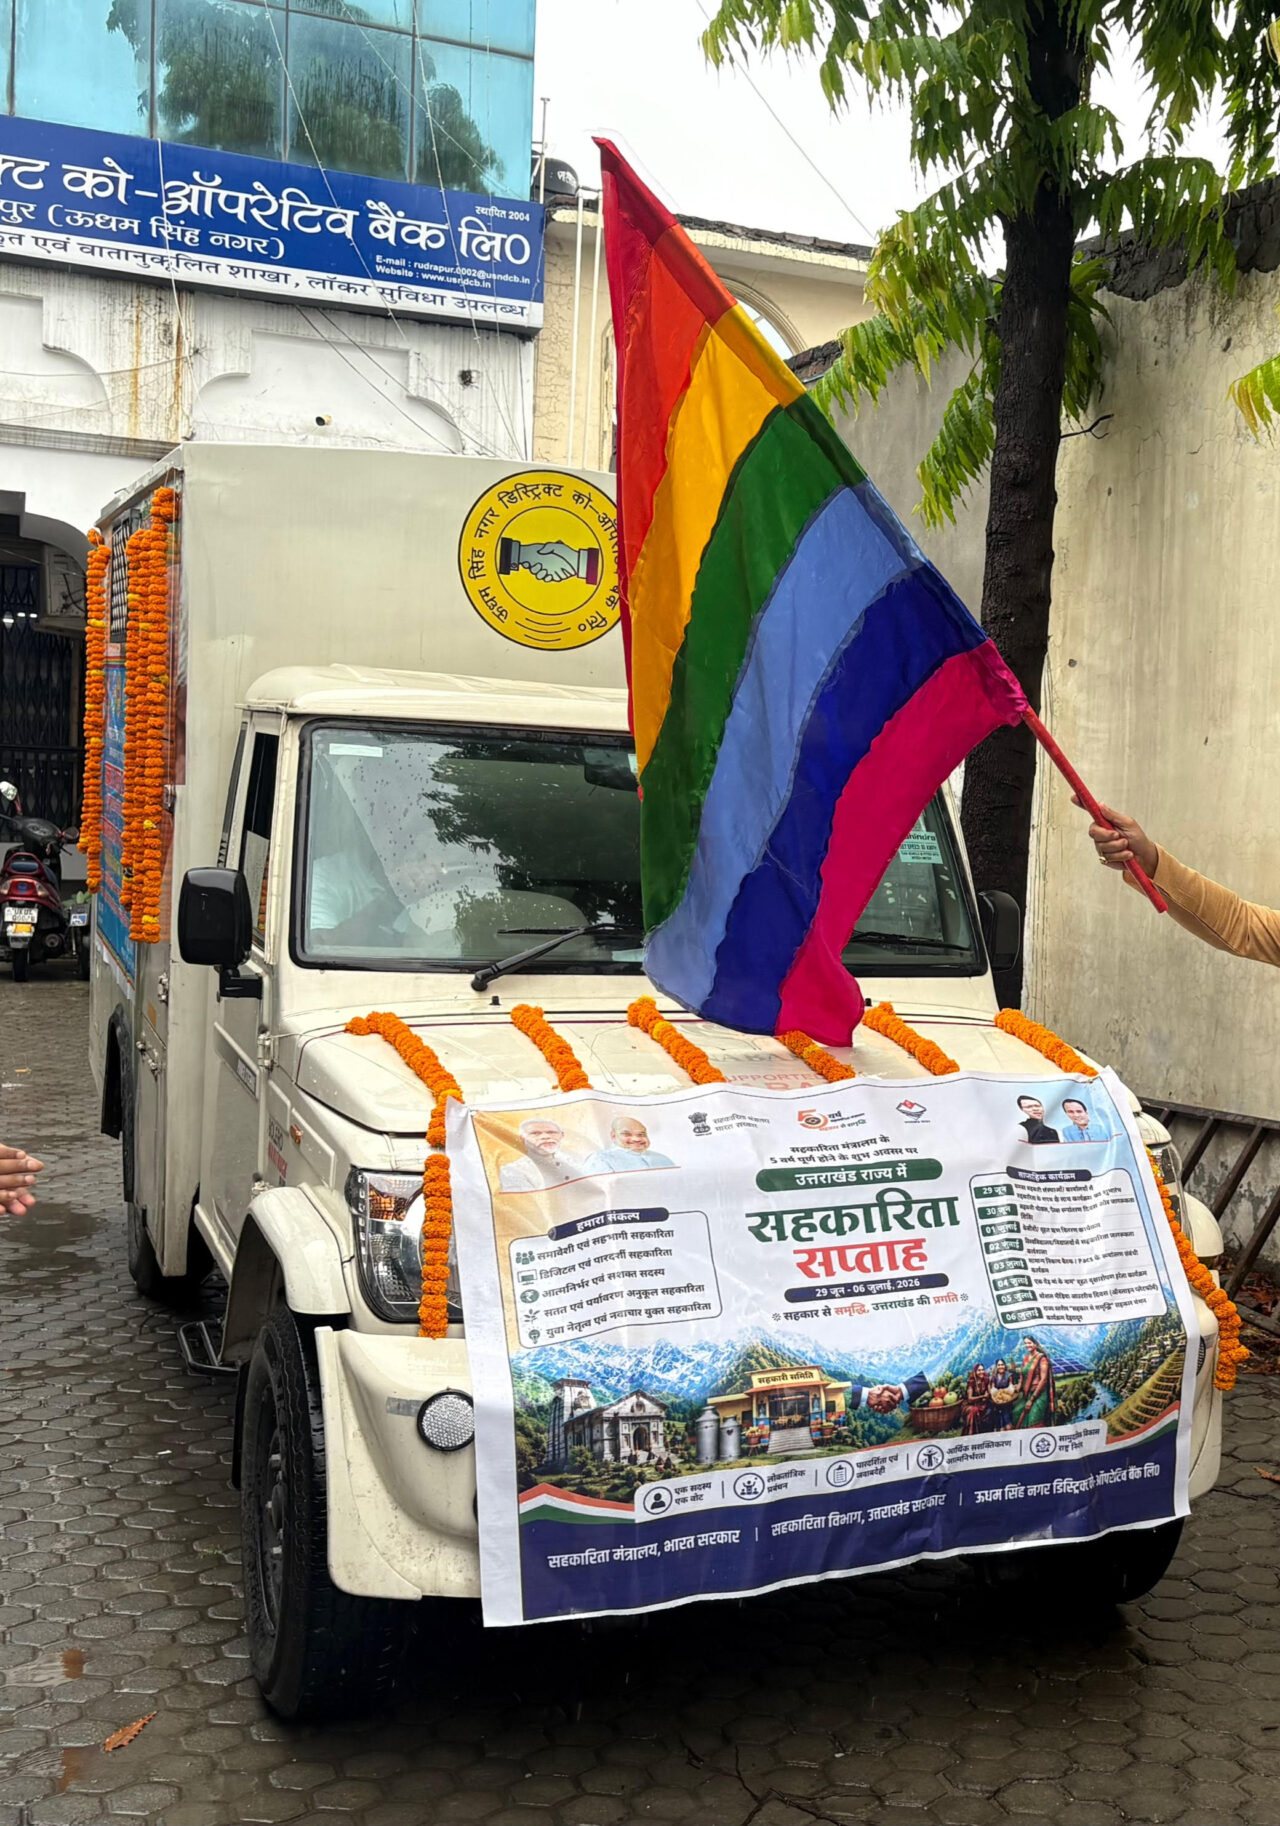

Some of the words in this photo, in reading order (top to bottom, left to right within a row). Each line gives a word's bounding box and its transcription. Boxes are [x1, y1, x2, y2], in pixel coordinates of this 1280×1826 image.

[366, 199, 450, 251] बैंक
[475, 206, 507, 219] स्थापित
[508, 211, 530, 222] 2004
[150, 217, 201, 247] सिंह
[209, 230, 285, 259] नगर)
[31, 236, 71, 254] एवं
[76, 242, 221, 274] वातानुकूलित
[306, 275, 370, 297] लॉकर
[377, 284, 447, 306] सुविधा
[375, 255, 406, 267] E-mail
[375, 265, 414, 278] Website
[497, 482, 565, 509] डिस्ट्रिक्ट
[474, 507, 500, 539] नगर
[467, 547, 487, 580] सिंह
[477, 586, 510, 624] ऊधम
[790, 1142, 840, 1154] सहकारिता
[841, 1136, 877, 1150] मंत्रालय
[879, 1134, 891, 1145] के
[780, 1155, 797, 1163] वर्ष
[798, 1153, 816, 1165] पूर्ण
[819, 1152, 836, 1163] होने
[838, 1152, 849, 1162] के
[851, 1151, 871, 1162] शुभ
[906, 1147, 918, 1155] पर
[795, 1168, 858, 1186] उत्तराखंड
[860, 1166, 892, 1183] राज्य
[895, 1163, 908, 1179] में
[982, 1186, 993, 1195] 29
[576, 1214, 604, 1232] हमारा
[606, 1210, 640, 1224] संकल्प
[745, 1187, 961, 1243] सहकारिता
[986, 1207, 996, 1215] 30
[985, 1226, 996, 1234] 01
[536, 1243, 575, 1261] समावेशी
[576, 1238, 590, 1251] एवं
[591, 1229, 629, 1246] सहभागी
[630, 1227, 675, 1240] सहकारिता
[989, 1243, 999, 1251] 02
[539, 1263, 576, 1280] डिजिटल
[577, 1257, 592, 1271] एवं
[593, 1248, 627, 1265] पारदर्शी
[629, 1246, 673, 1260] सहकारिता
[793, 1238, 928, 1279] सप्ताह
[994, 1262, 1005, 1270] 03
[541, 1278, 590, 1298] आत्मनिर्भर
[591, 1273, 605, 1286] एवं
[607, 1269, 638, 1281] सशक्त
[639, 1267, 665, 1278] सदस्य
[815, 1288, 829, 1297] 29
[830, 1286, 847, 1298] जून
[853, 1284, 865, 1294] 06
[896, 1278, 921, 1289] 2026
[997, 1280, 1009, 1288] 04
[543, 1305, 567, 1318] सतत
[569, 1299, 584, 1312] एवं
[586, 1291, 624, 1307] पर्यावरण
[626, 1288, 659, 1300] अनुकूल
[660, 1283, 705, 1296] सहकारिता
[783, 1308, 820, 1321] सहकार
[822, 1305, 832, 1317] से
[872, 1297, 914, 1311] उत्तराखंड
[916, 1294, 931, 1305] की
[932, 1291, 959, 1305] प्रगति
[1001, 1294, 1012, 1303] 05
[546, 1325, 565, 1339] युवा
[567, 1317, 592, 1333] नेतृत्व
[594, 1312, 608, 1325] एवं
[609, 1307, 642, 1320] नवाचार
[644, 1307, 665, 1319] युक्त
[667, 1301, 712, 1315] सहकारिता
[1005, 1313, 1016, 1321] 06
[757, 1372, 788, 1385] सहकारी
[790, 1370, 814, 1380] समिति
[766, 1468, 806, 1483] लोकतांत्रिक
[974, 1488, 1003, 1505] ऊधम
[1004, 1483, 1026, 1501] सिंह
[1027, 1482, 1051, 1497] नगर
[1127, 1464, 1142, 1480] बैंक
[674, 1487, 688, 1495] एक
[690, 1482, 712, 1492] सदस्य
[690, 1493, 704, 1504] वोट
[771, 1513, 826, 1537] सहकारिता
[867, 1500, 910, 1522] उत्तराखंड
[912, 1493, 947, 1513] सरकार
[548, 1548, 611, 1569] सहकारिता
[664, 1535, 695, 1553] भारत
[697, 1529, 741, 1547] सरकार
